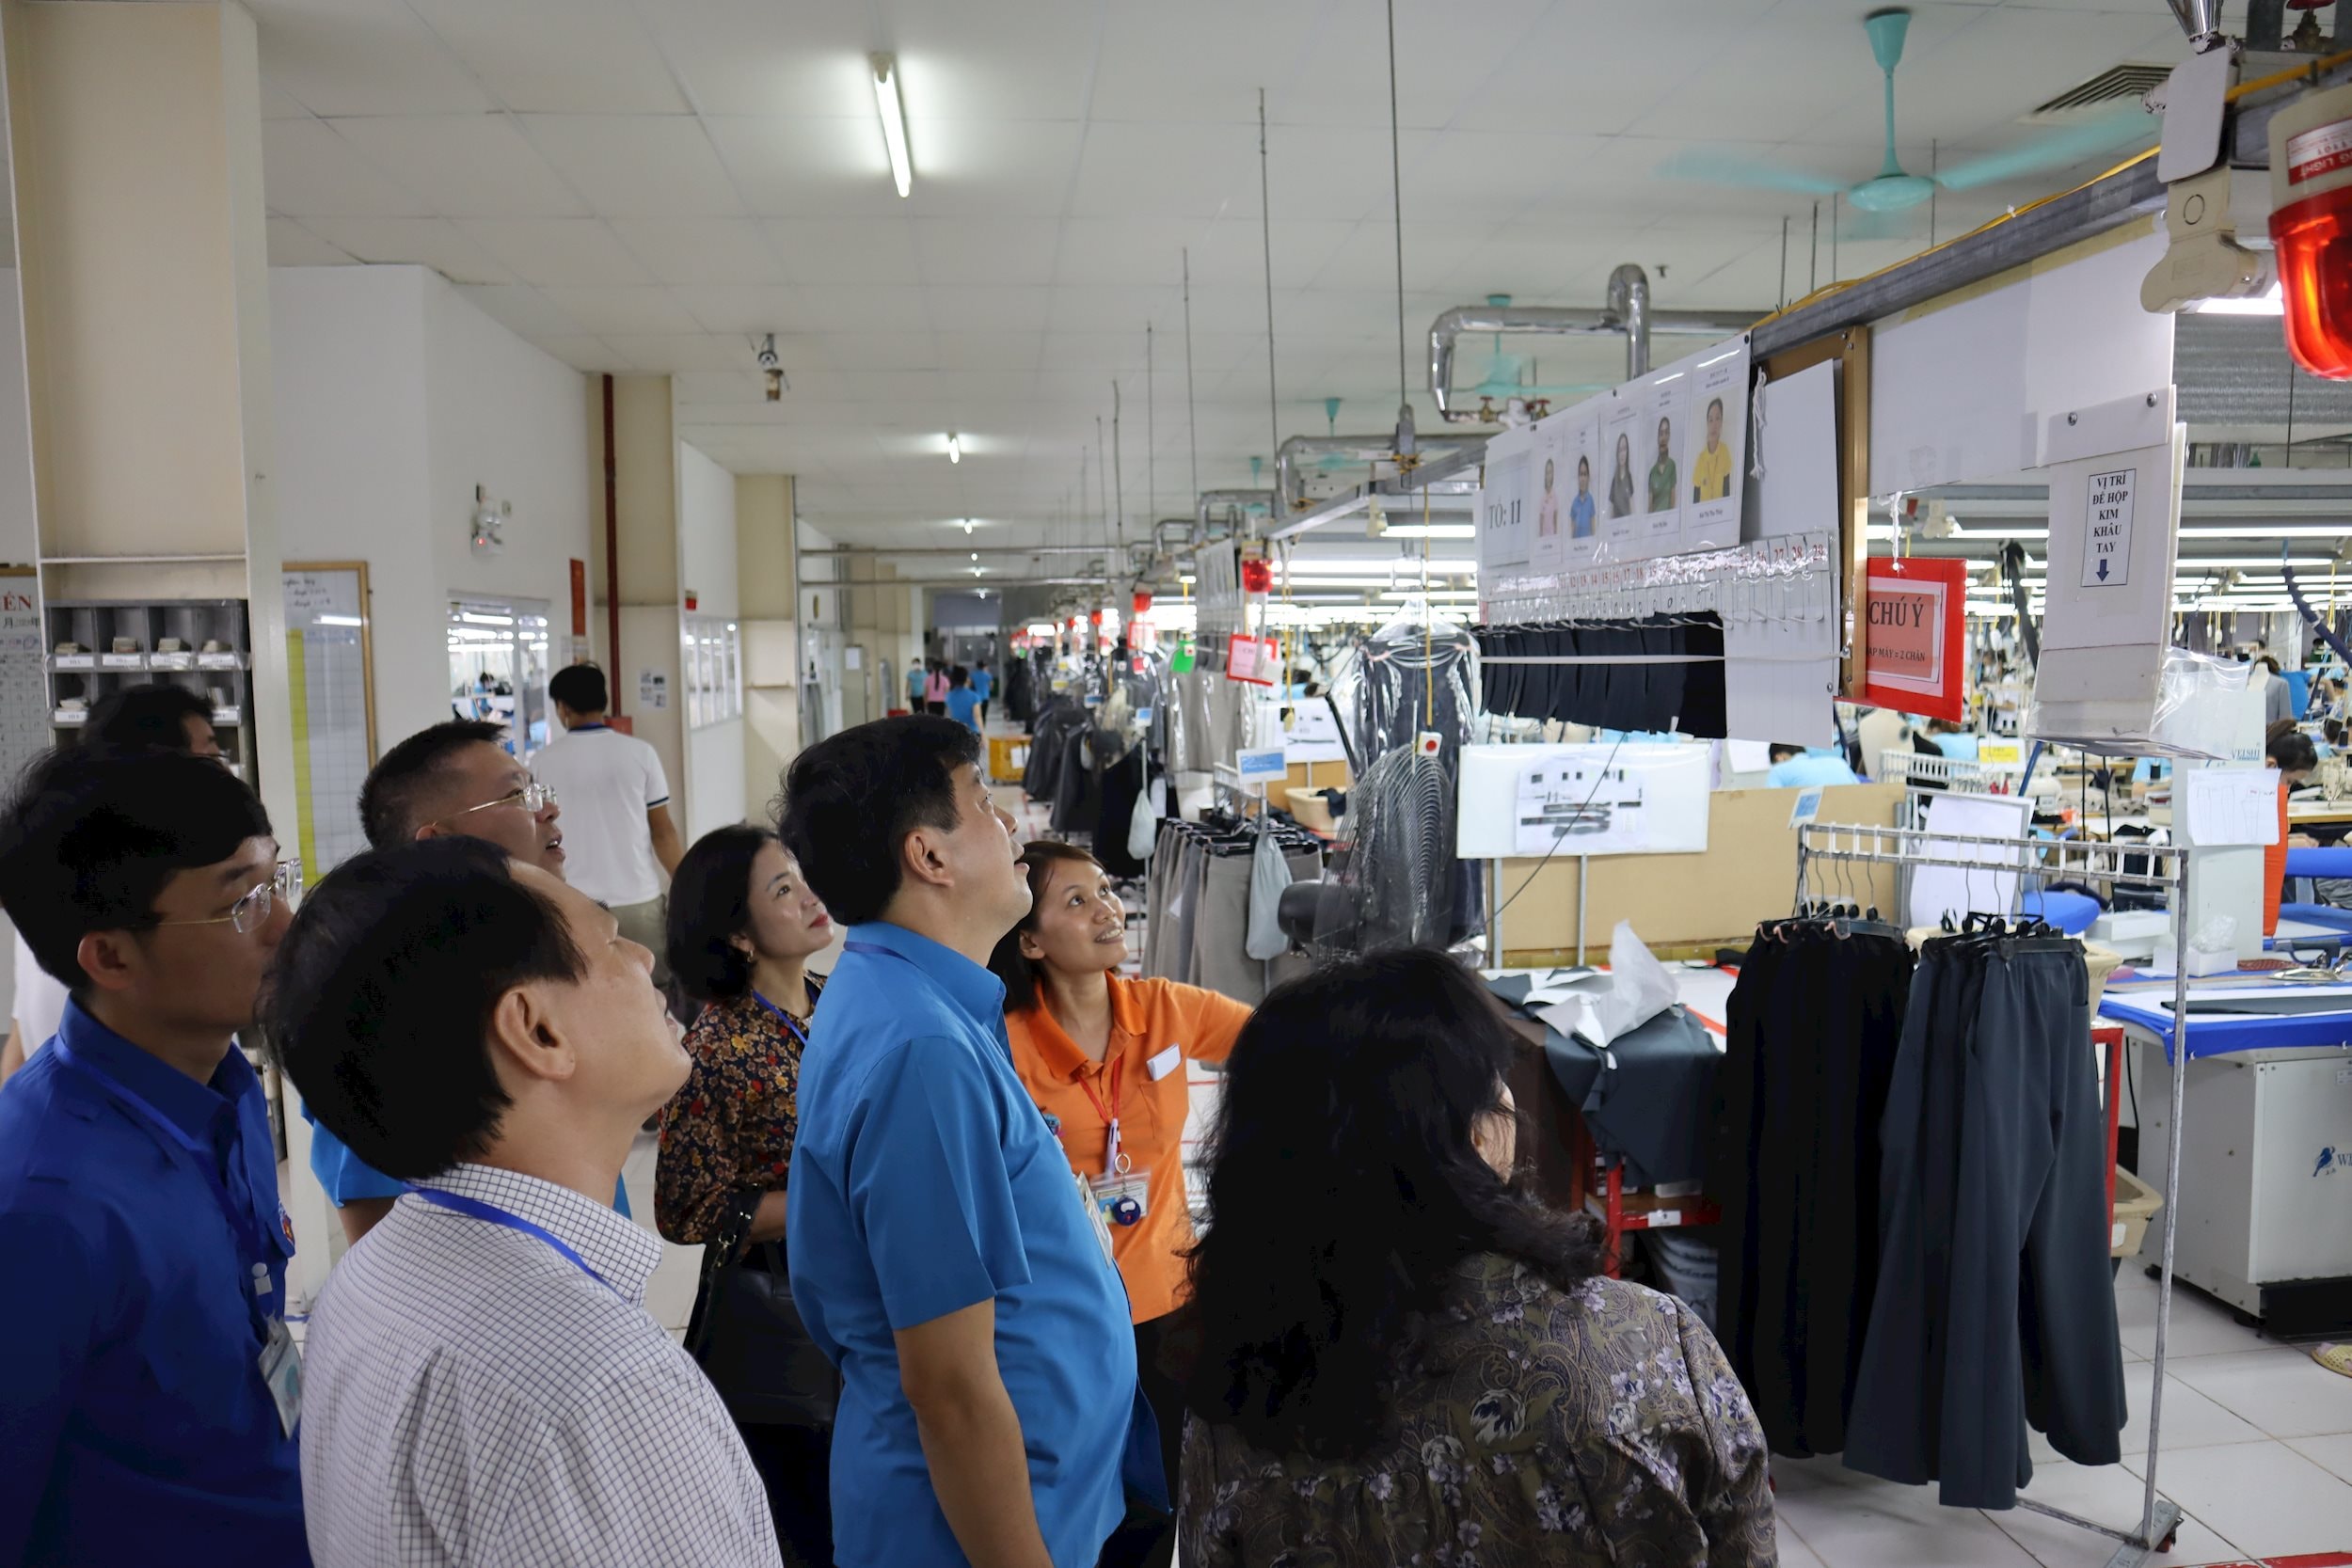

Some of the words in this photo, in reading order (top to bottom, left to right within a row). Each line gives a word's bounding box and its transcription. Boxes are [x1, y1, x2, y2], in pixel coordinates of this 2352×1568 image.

[2098, 508, 2119, 521] KIM
[2093, 522, 2122, 538] KHÂU
[2096, 542, 2117, 553] TAY
[1869, 595, 1907, 626] CHÚ
[1912, 596, 1924, 627] Ý
